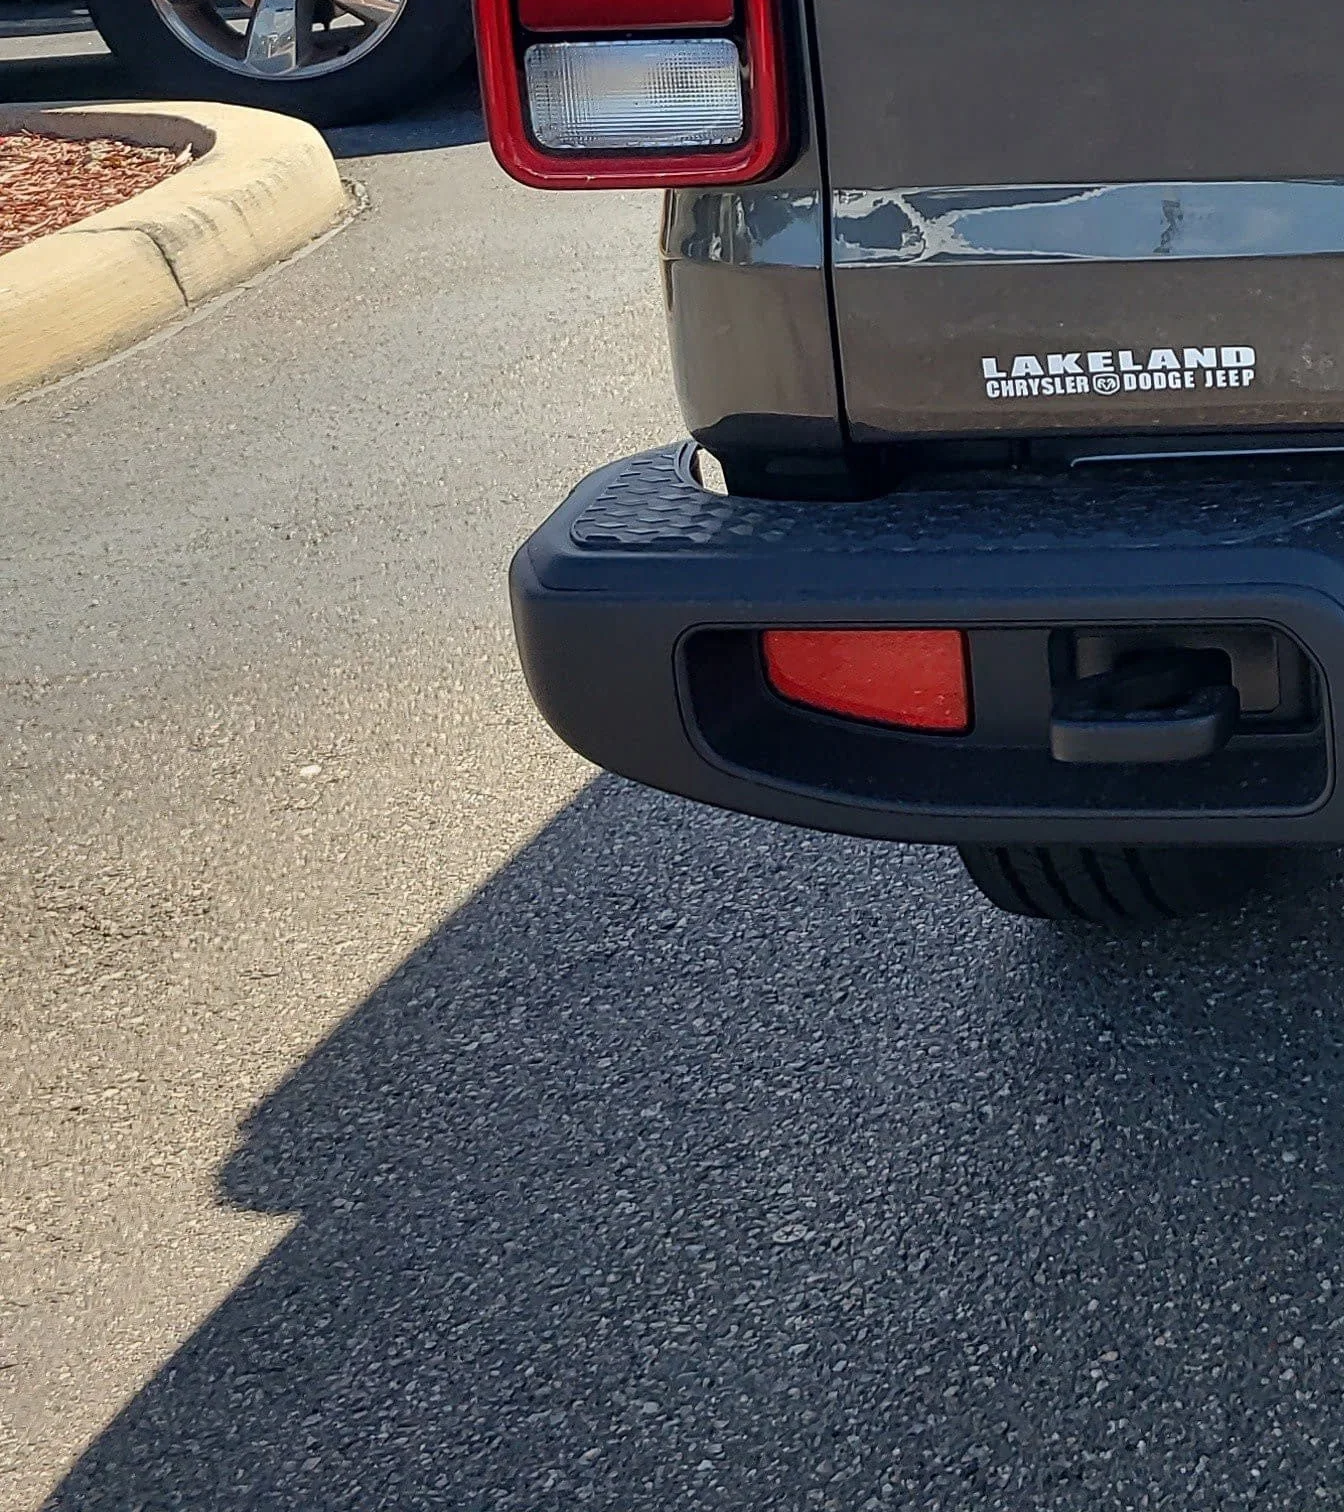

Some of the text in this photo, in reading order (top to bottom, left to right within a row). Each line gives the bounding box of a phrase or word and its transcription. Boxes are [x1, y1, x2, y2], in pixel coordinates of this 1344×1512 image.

[981, 346, 1257, 379] LAKELAND
[985, 368, 1255, 399] CHRYSLER DODGE JEEP
